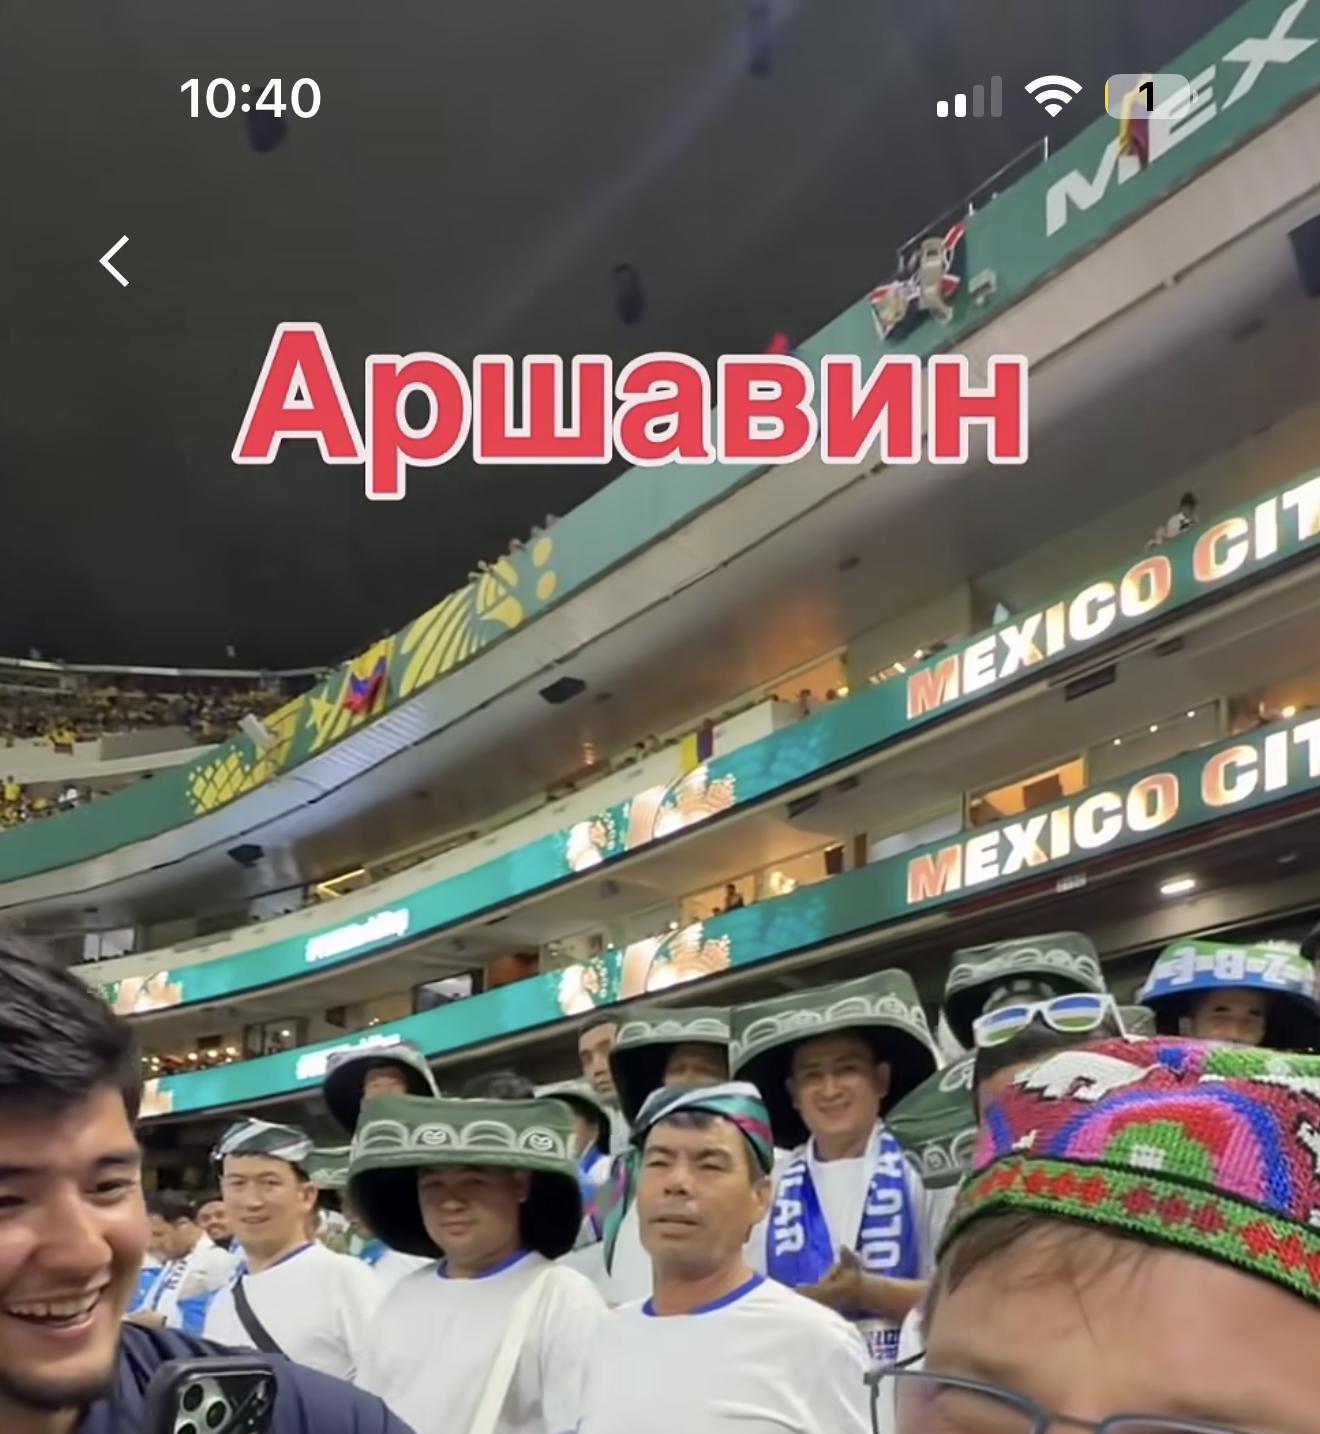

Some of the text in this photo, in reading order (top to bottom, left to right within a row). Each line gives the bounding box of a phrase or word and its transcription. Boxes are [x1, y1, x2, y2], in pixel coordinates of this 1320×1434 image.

[1047, 0, 1318, 237] MEX
[907, 555, 1172, 719] MEXICO
[907, 772, 1179, 904] MEXICO
